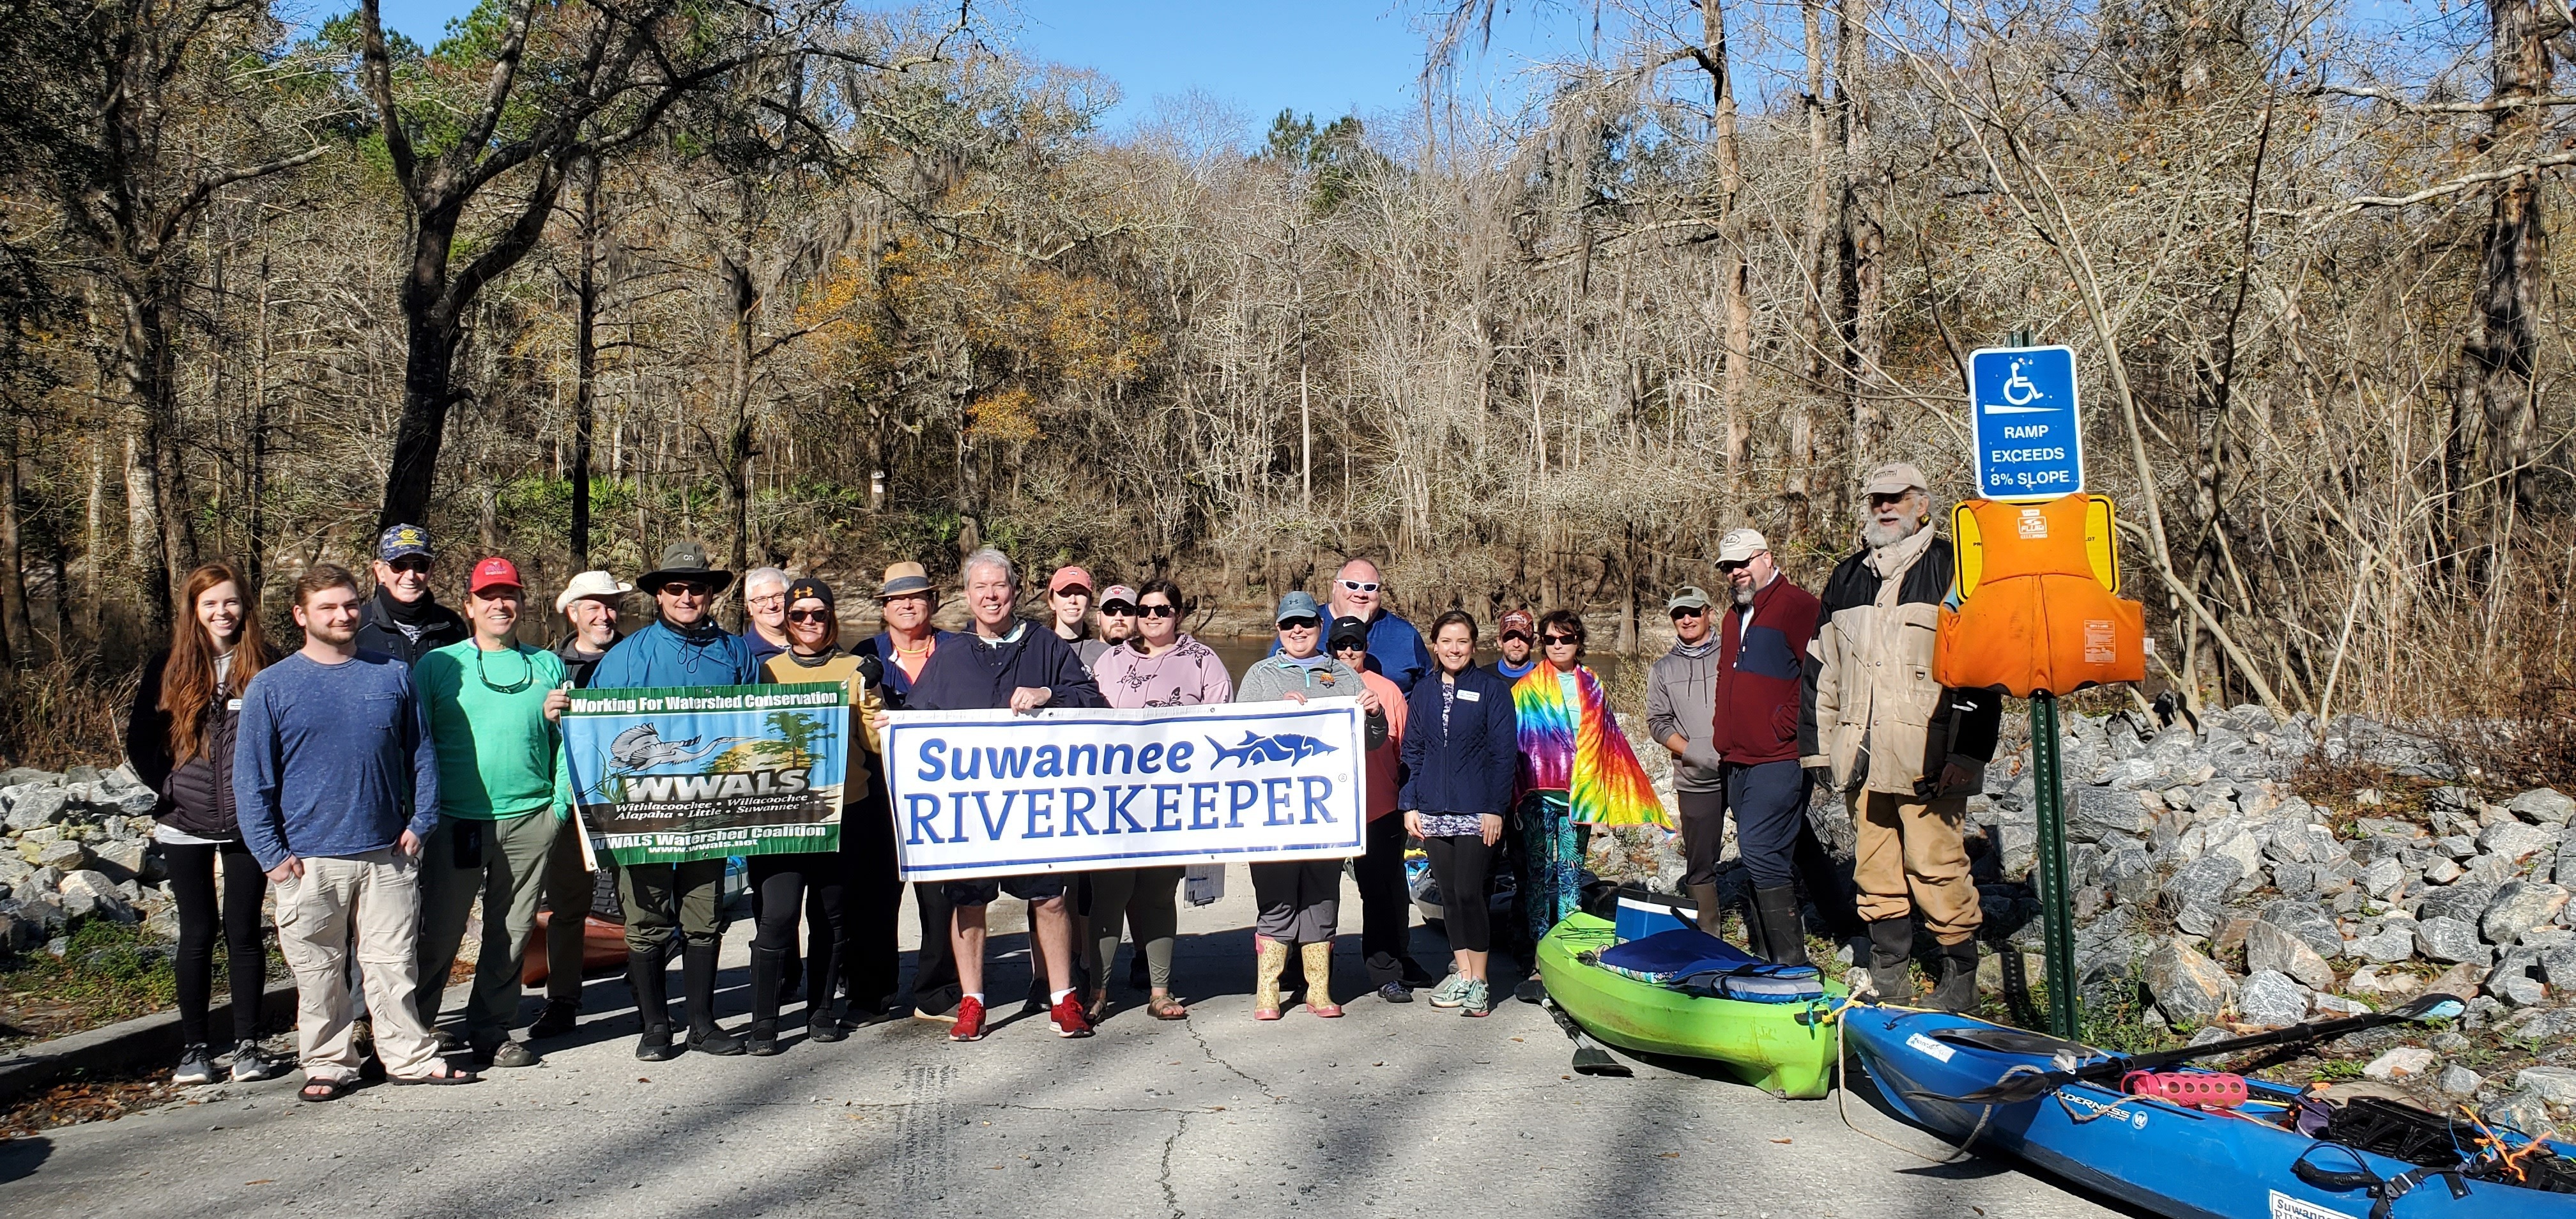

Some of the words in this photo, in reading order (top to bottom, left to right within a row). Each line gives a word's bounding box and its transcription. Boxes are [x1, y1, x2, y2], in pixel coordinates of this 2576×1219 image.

[2004, 425, 2049, 439] RAMP
[1992, 447, 2065, 463] EXCEEDS
[1990, 473, 2013, 486] 8%
[2017, 470, 2069, 485] SLOPE
[571, 698, 636, 712] Working
[640, 697, 664, 711] For
[665, 694, 742, 710] Watershed
[744, 691, 838, 708] Conservation
[917, 738, 1194, 781] Suwannee
[625, 769, 806, 802] WWALS
[615, 801, 712, 813] Withlacoochee
[727, 794, 808, 806] Willacoochee
[615, 810, 673, 820] Alapaha
[687, 808, 723, 818] Little
[736, 802, 800, 813] Suwannee
[904, 775, 1338, 845] RIVERKEEPER
[591, 835, 653, 850] WWALS
[656, 829, 748, 846] Watershed
[751, 825, 825, 839] Coalition
[648, 839, 758, 853] www.wwals.net
